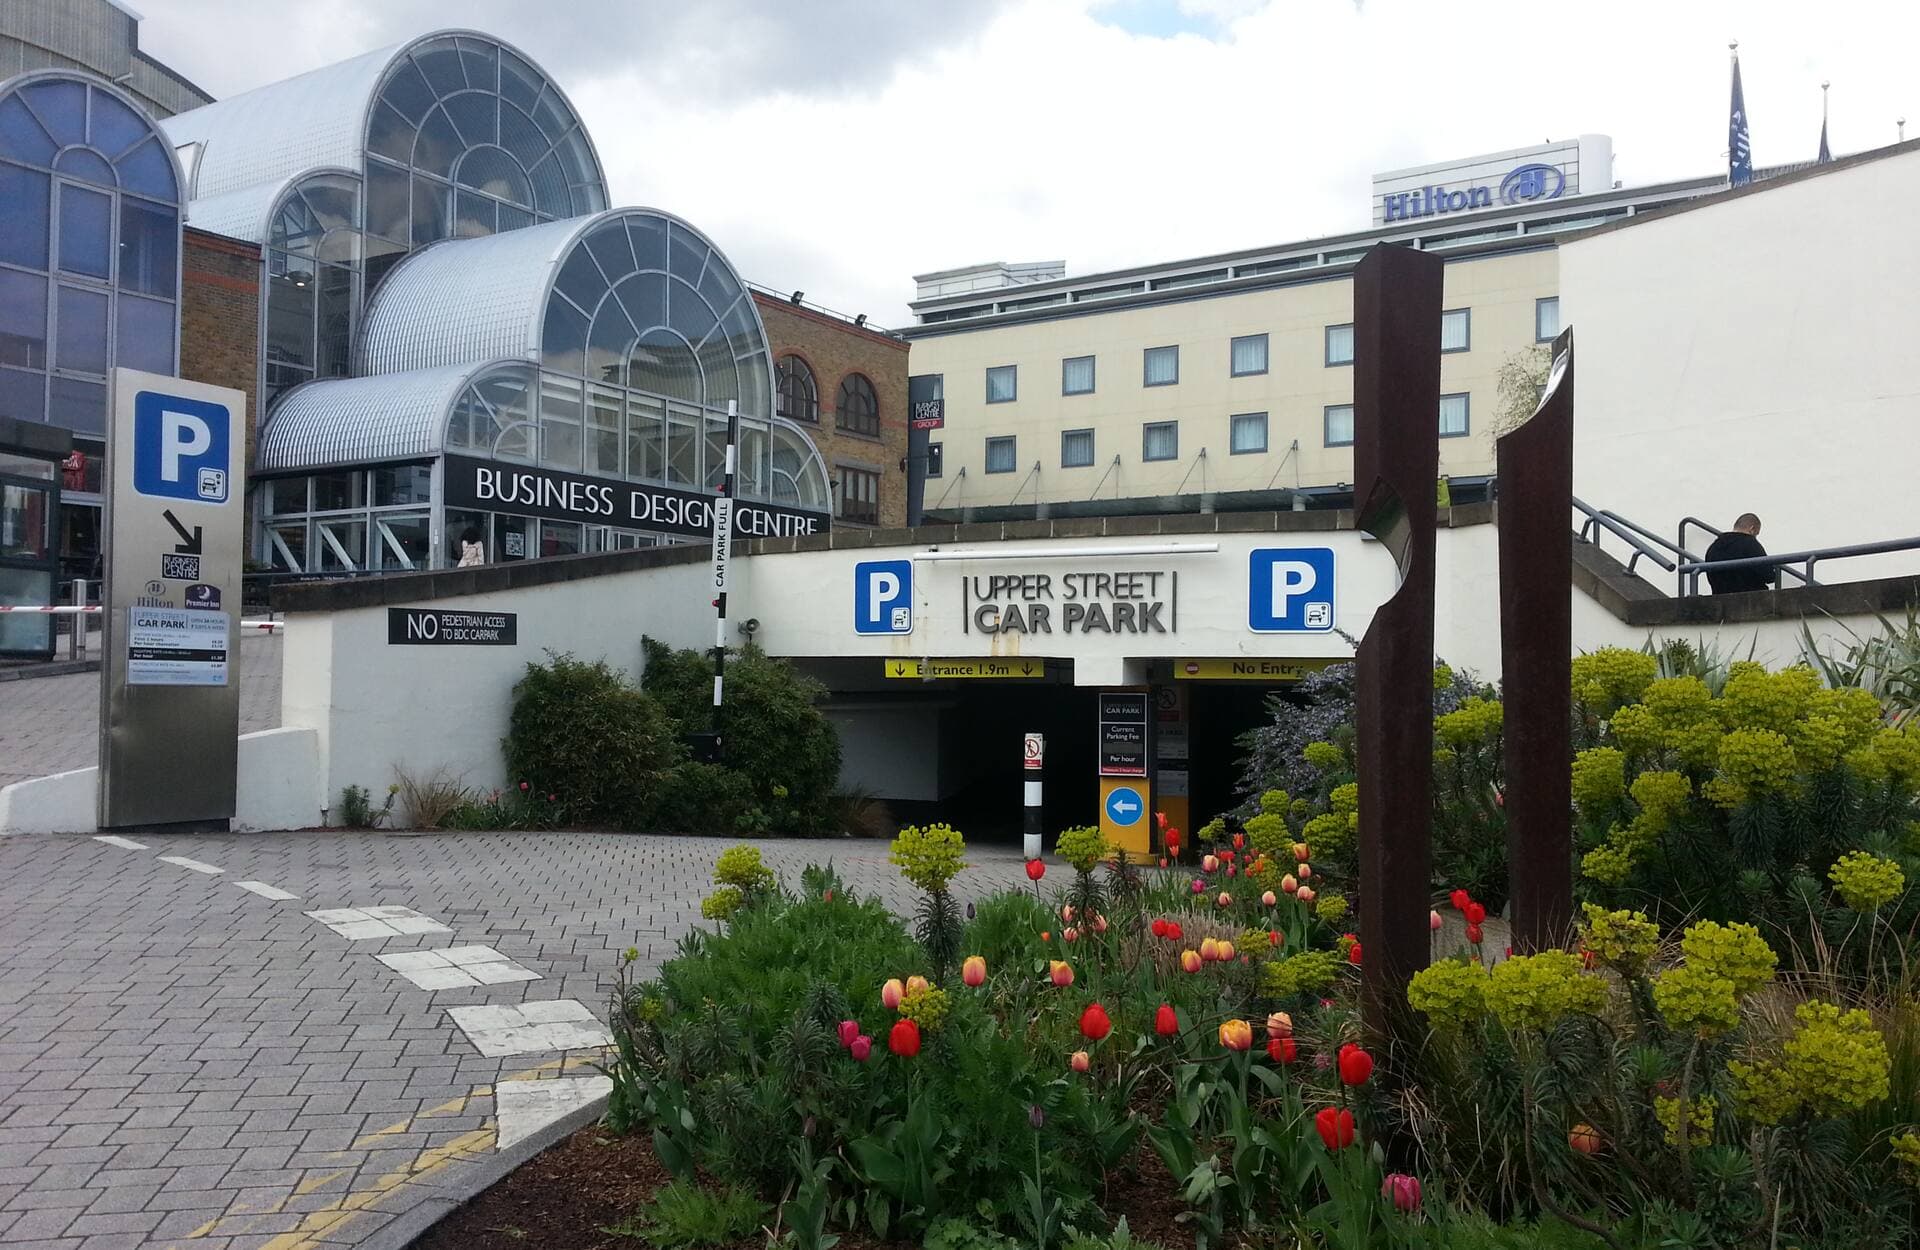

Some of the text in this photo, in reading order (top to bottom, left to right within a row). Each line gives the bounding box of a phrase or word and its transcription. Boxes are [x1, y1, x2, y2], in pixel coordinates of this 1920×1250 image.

[1383, 185, 1492, 222] Hilton
[161, 410, 211, 482] P
[476, 467, 818, 537] BUSINESS DESIGN CENTRE
[716, 503, 728, 587] CAR PARK FULL
[869, 572, 901, 622] P
[973, 571, 1164, 601] UPPER STREET
[1271, 561, 1317, 618] P
[137, 597, 173, 608] Hilton
[186, 599, 209, 607] Premier
[137, 619, 185, 629] CAR PARK
[407, 613, 438, 640] NO
[441, 614, 506, 628] PEDESTRIAN ACCESS
[973, 602, 1167, 634] CAR PARK
[442, 628, 500, 641] TO BDC CARPARK
[979, 663, 1009, 675] 1.9m
[1233, 662, 1255, 674] No
